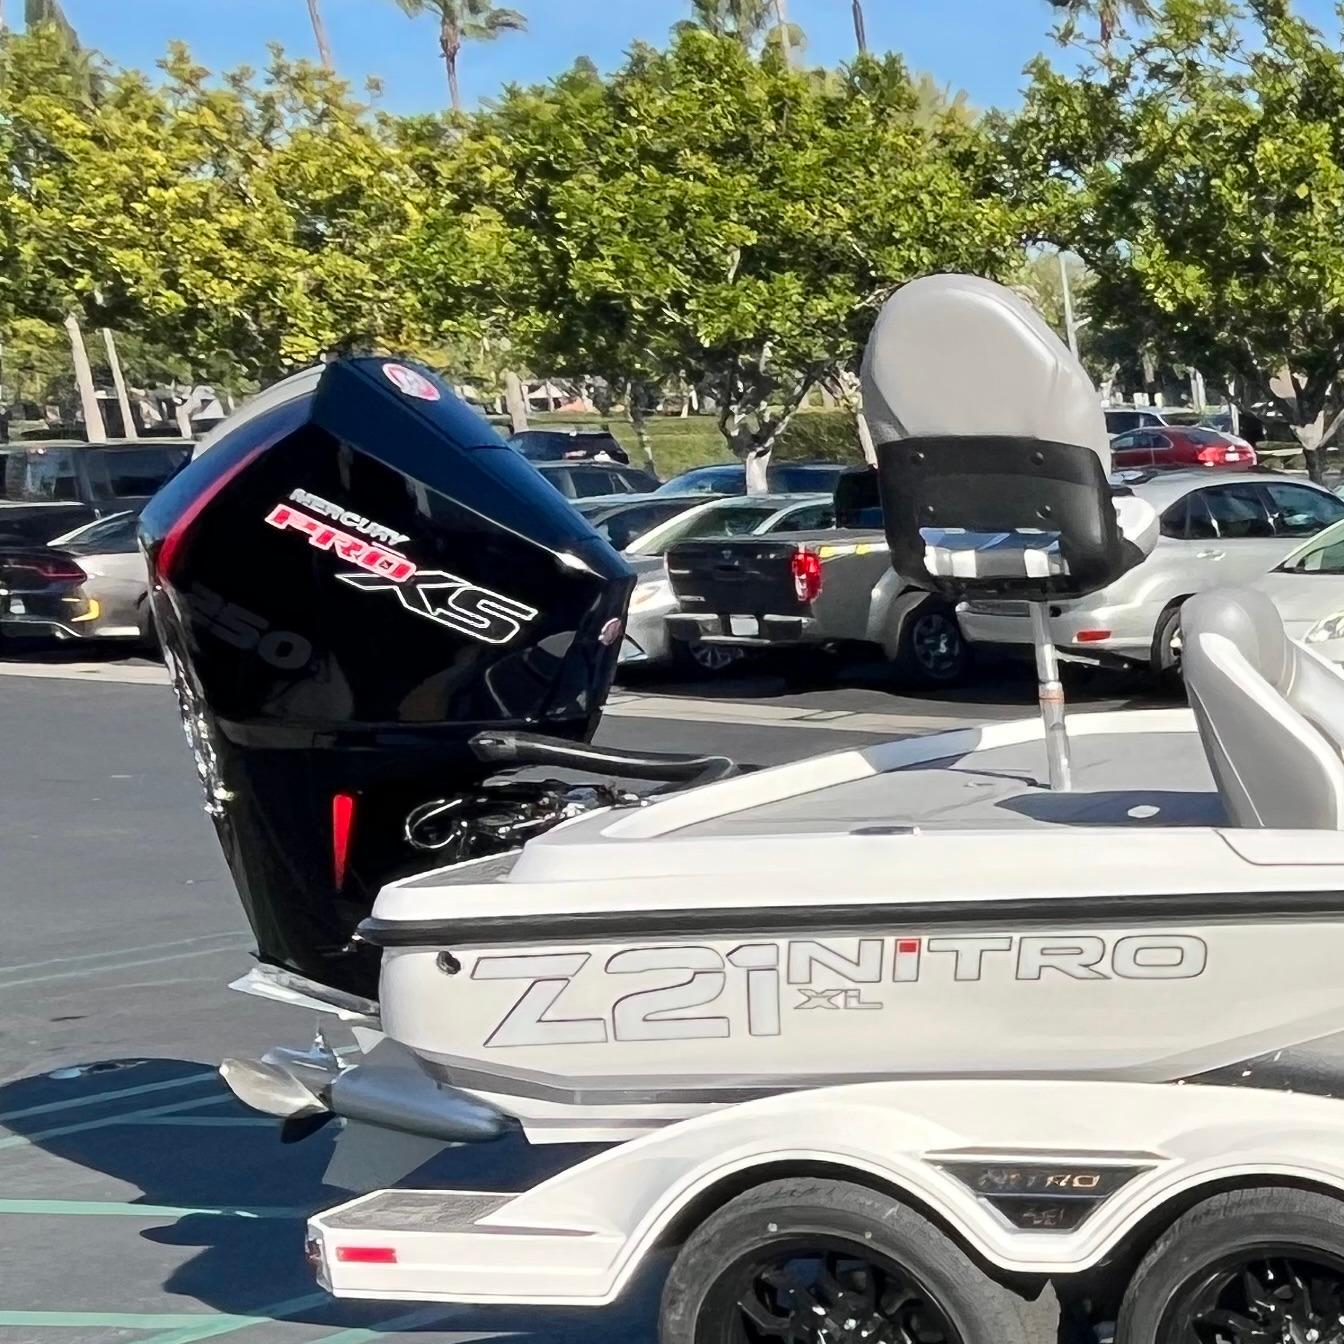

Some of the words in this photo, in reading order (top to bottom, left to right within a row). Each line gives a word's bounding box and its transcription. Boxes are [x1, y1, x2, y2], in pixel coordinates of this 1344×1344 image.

[263, 503, 418, 584] PRO
[289, 487, 412, 546] MERCURY
[335, 570, 539, 644] XS
[468, 943, 782, 1048] Z21
[792, 988, 884, 1010] XL
